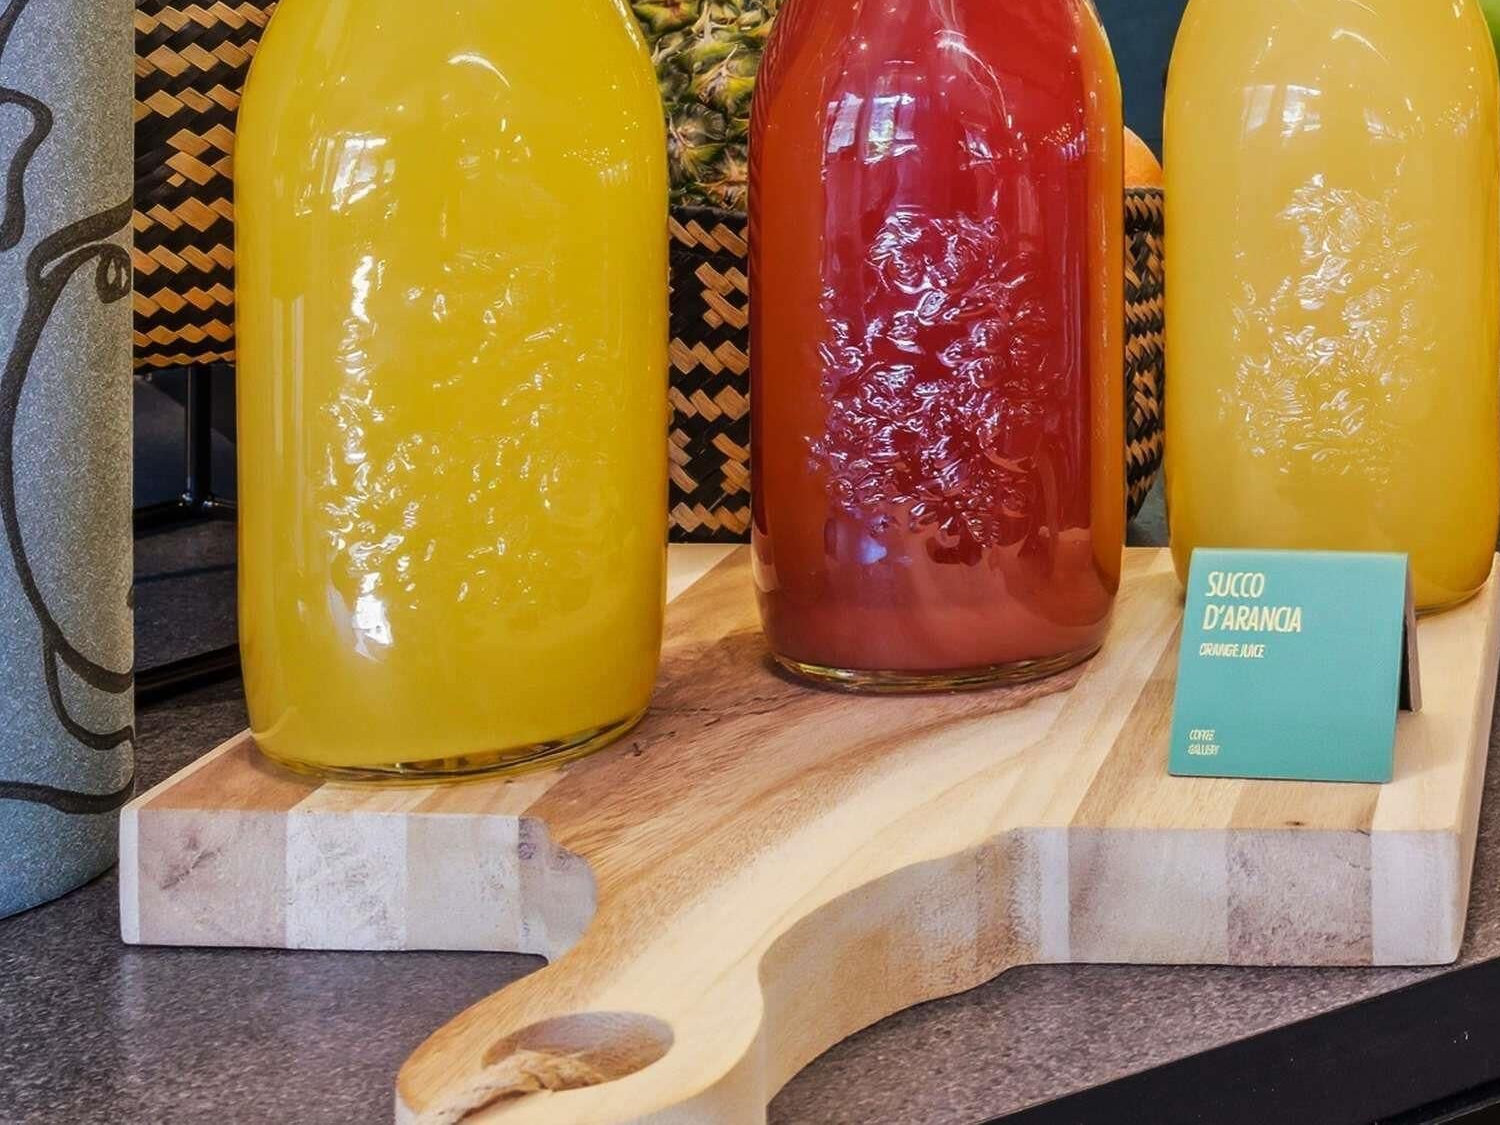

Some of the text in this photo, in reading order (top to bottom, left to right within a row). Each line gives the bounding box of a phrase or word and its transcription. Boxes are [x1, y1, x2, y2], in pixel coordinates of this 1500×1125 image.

[1205, 571, 1265, 598] SUCCO
[1202, 604, 1303, 633] D'ARANCIA
[1199, 642, 1266, 659] ORANGE JUICE
